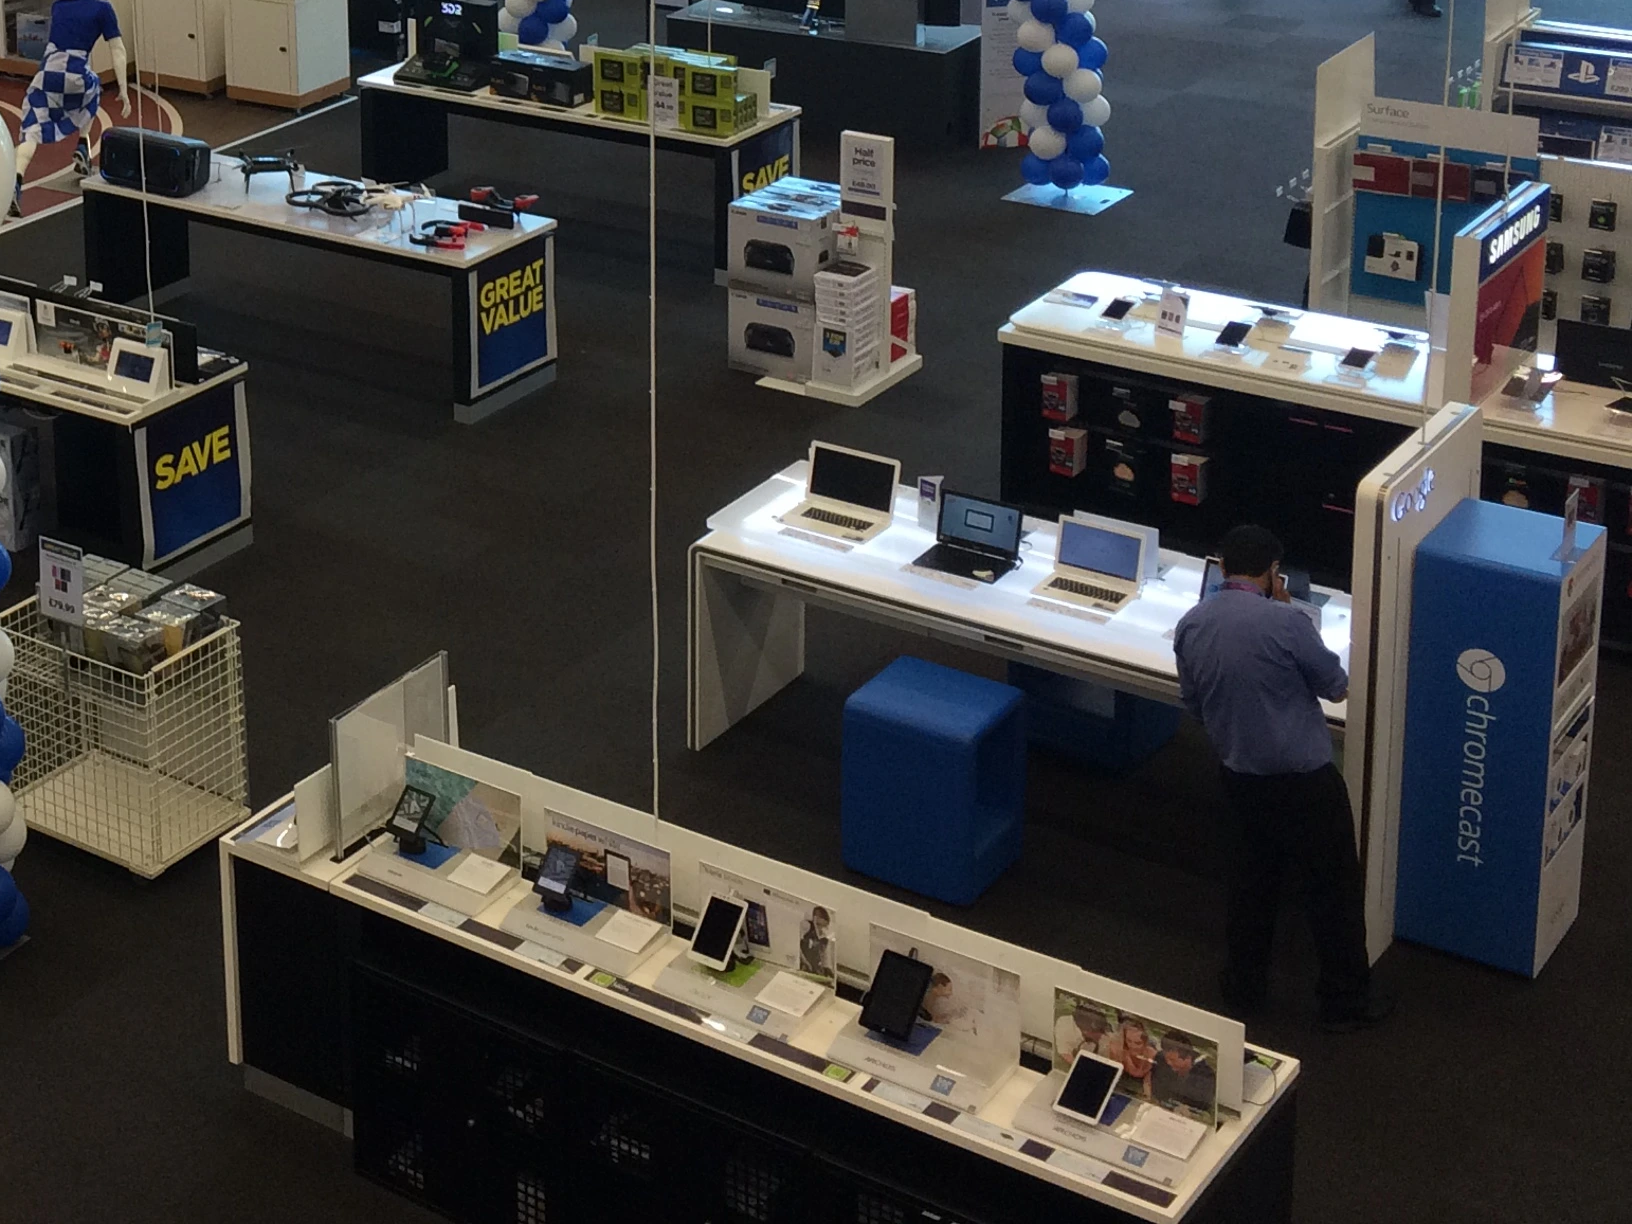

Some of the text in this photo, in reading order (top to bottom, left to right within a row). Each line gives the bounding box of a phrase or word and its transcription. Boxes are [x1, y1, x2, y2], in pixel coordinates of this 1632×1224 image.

[1368, 103, 1410, 120] Surface
[742, 154, 790, 195] SAVE
[852, 157, 876, 168] price
[854, 146, 875, 158] Half
[1488, 204, 1541, 265] SAMSUNG
[480, 258, 544, 309] GREAT
[480, 284, 544, 336] VALUE
[155, 424, 232, 490] SAVE
[1390, 466, 1437, 524] Google
[1456, 692, 1497, 868] chromecast
